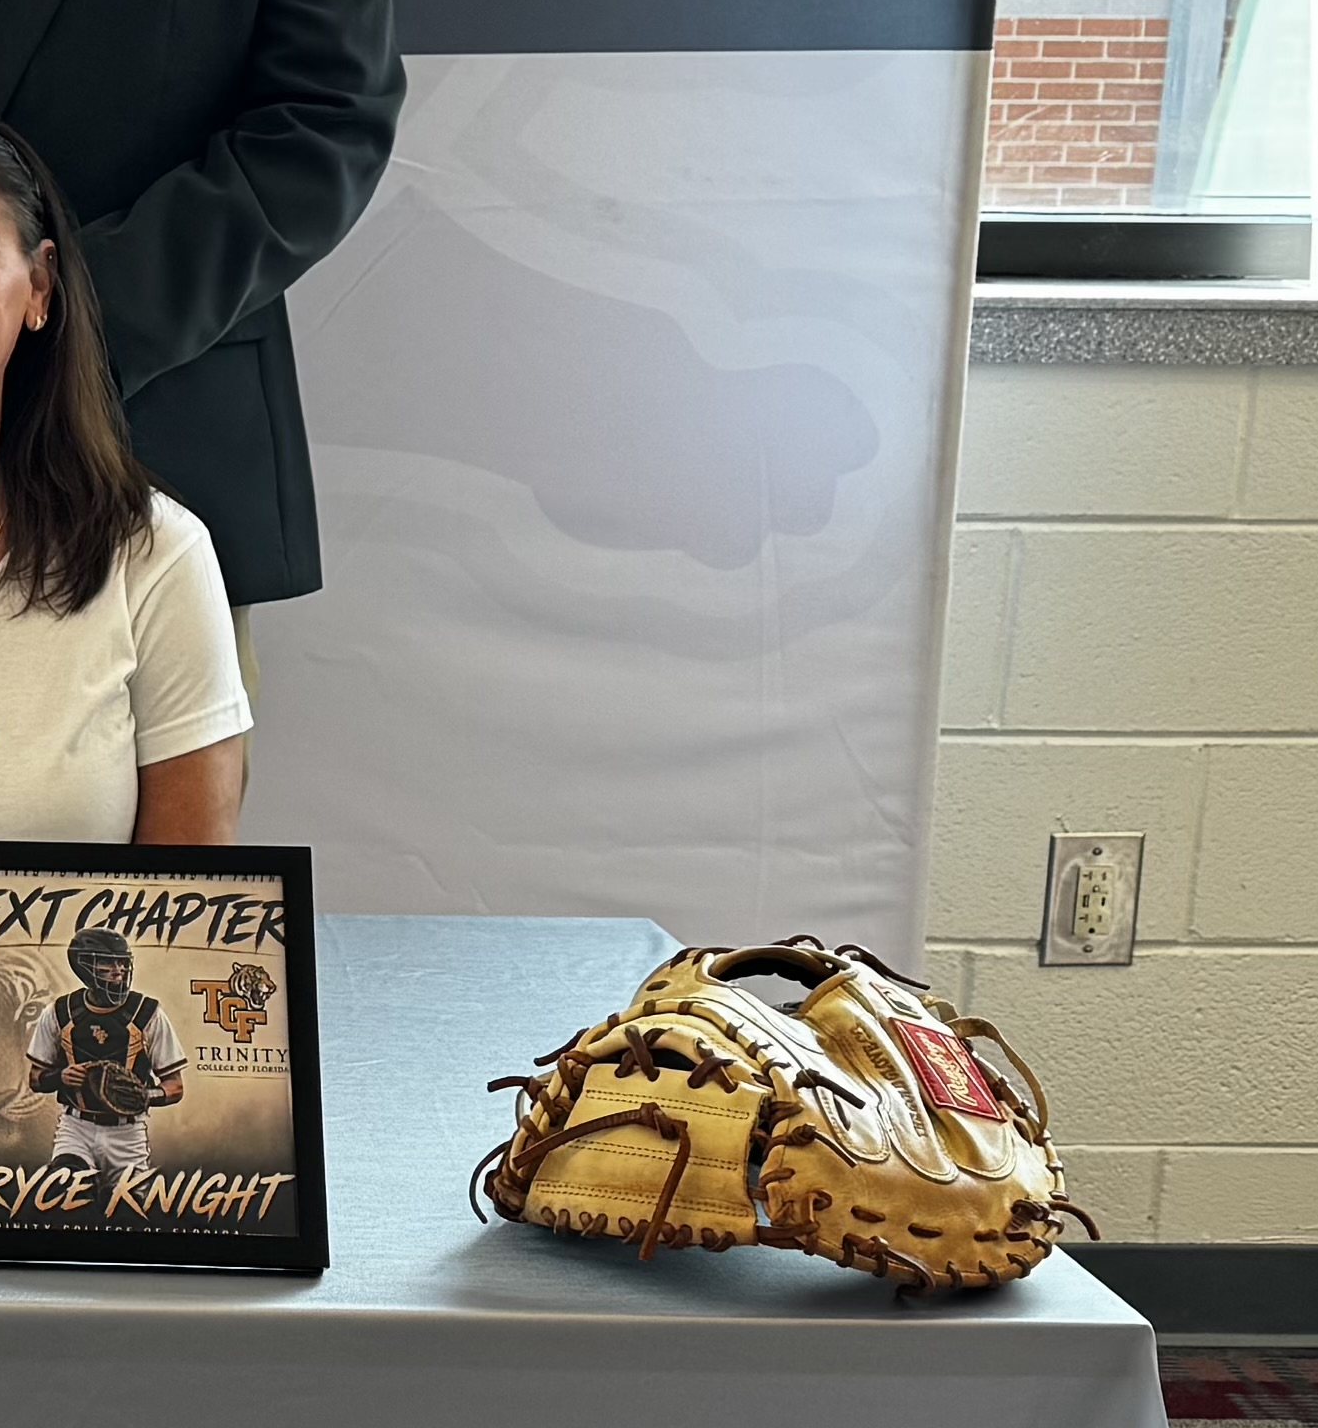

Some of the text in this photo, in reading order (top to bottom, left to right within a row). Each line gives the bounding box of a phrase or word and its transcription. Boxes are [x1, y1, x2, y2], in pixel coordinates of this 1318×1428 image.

[75, 888, 285, 952] CHAPTER
[195, 1046, 289, 1063] TRINITY
[196, 1063, 290, 1073] COLLEGE OF FLORIDA
[104, 1162, 296, 1223] KNIGHT
